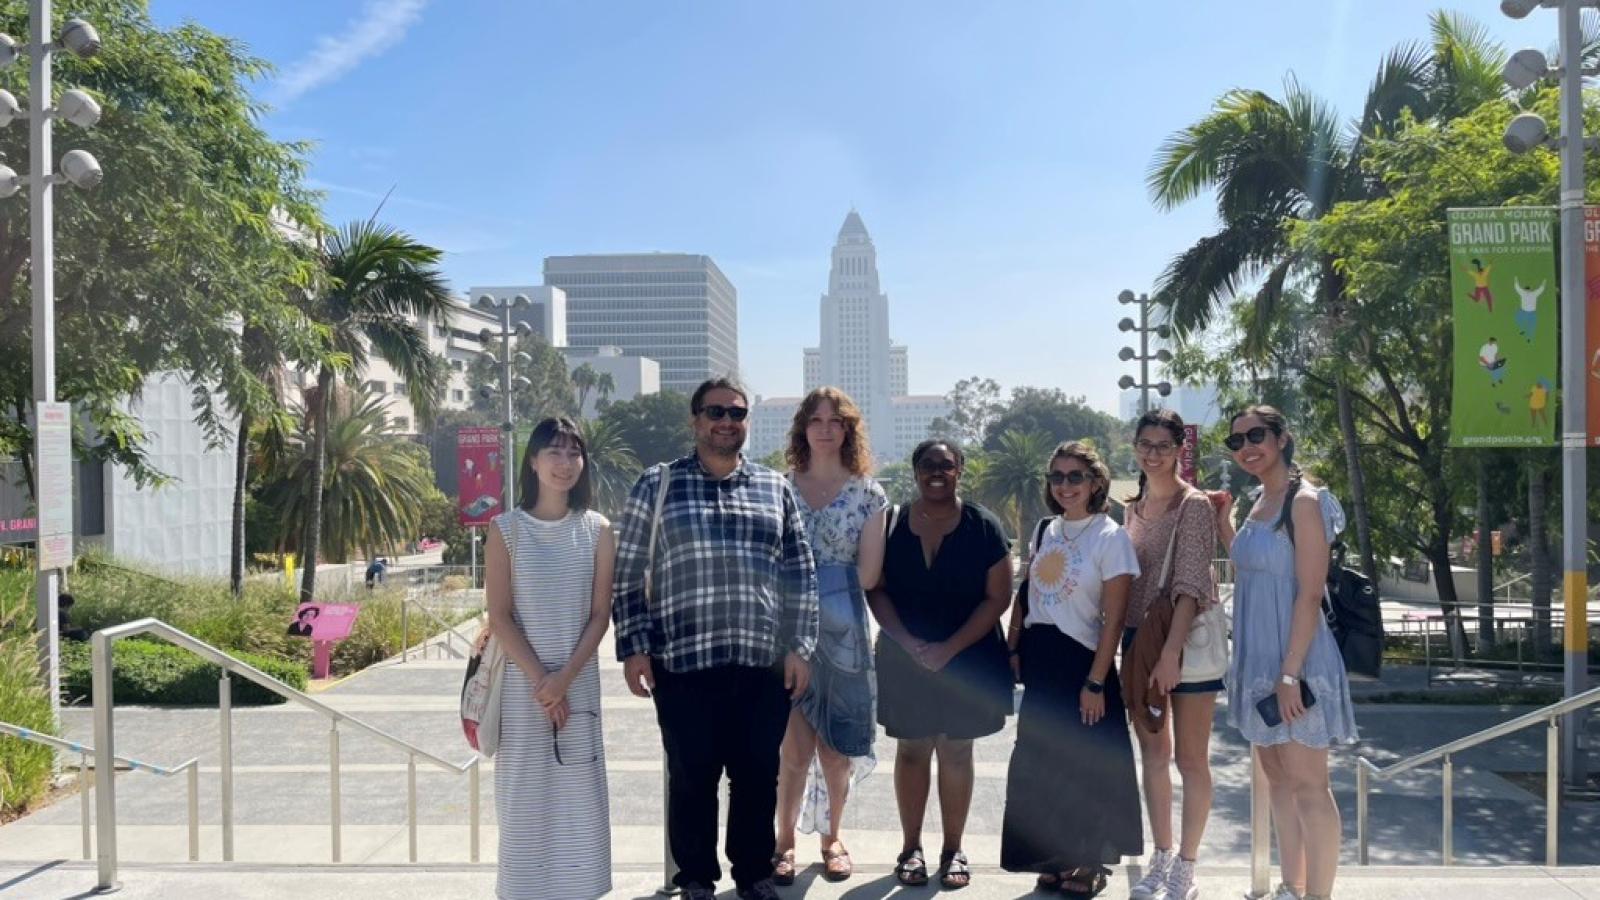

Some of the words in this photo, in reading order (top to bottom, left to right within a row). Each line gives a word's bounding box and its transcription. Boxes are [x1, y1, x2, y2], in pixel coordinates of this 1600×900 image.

[1451, 210, 1497, 219] GLORIA
[1504, 208, 1550, 218] MOLINA
[1451, 222, 1505, 245] GRAND
[1510, 221, 1551, 243] PARK
